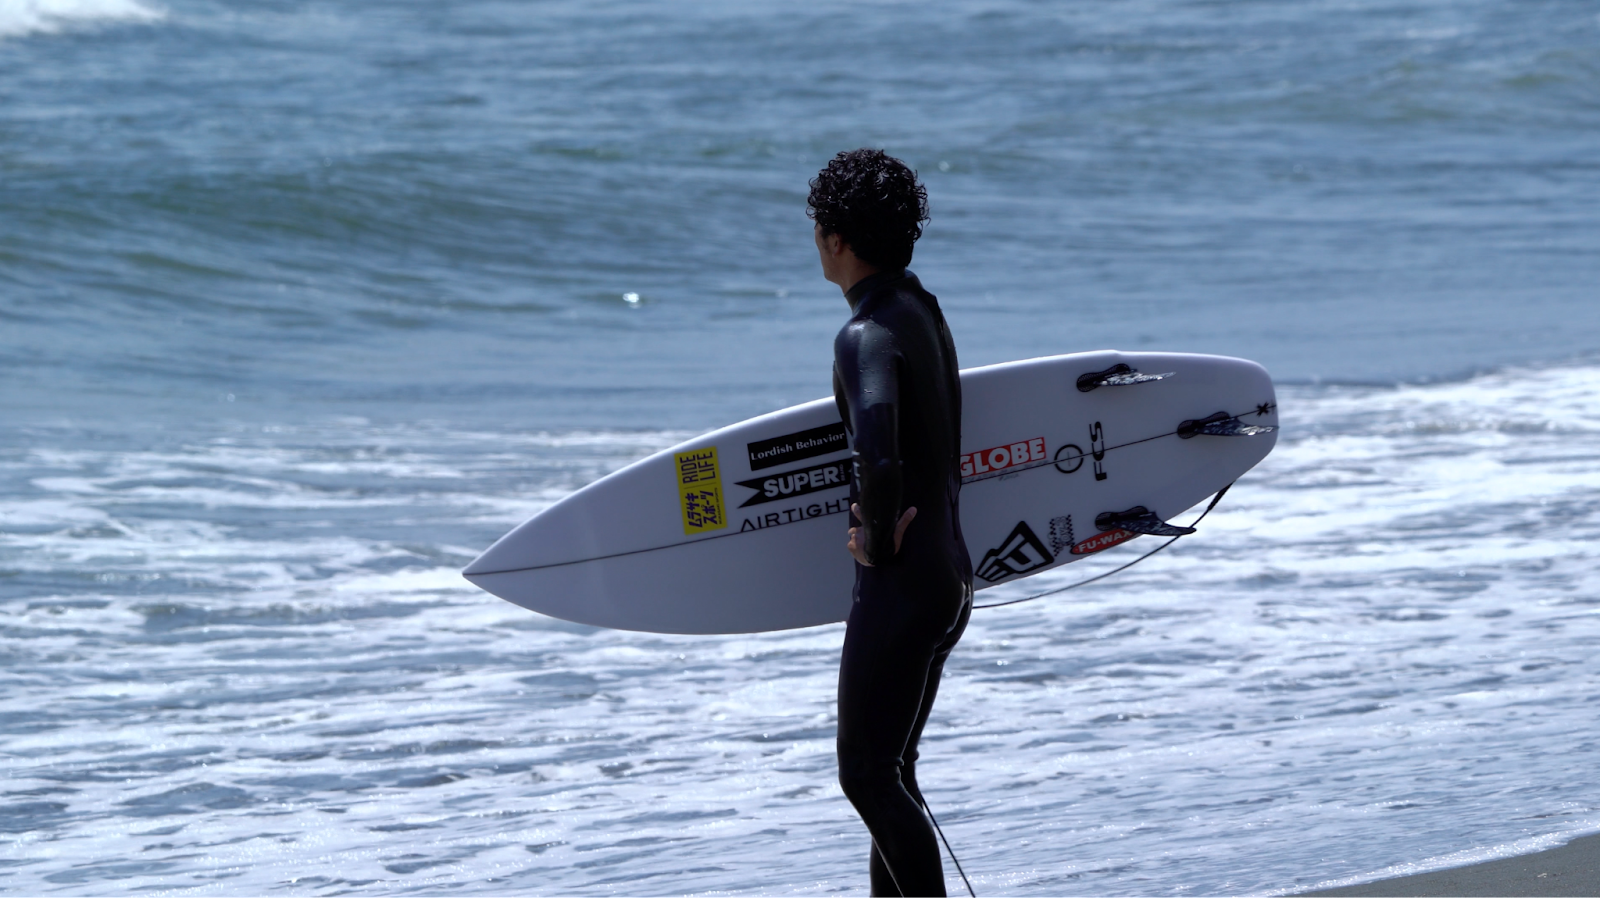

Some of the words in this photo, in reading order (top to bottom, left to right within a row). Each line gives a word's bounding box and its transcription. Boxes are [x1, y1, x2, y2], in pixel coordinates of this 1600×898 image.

[751, 443, 793, 461] Lordish
[796, 432, 845, 450] Behavior
[960, 438, 1045, 478] GLOBE
[680, 454, 699, 484] RIDE
[697, 451, 716, 481] LIFE
[763, 466, 841, 498] SUPER
[685, 493, 703, 528] ムラサキ
[700, 490, 718, 525] スポーツ
[1078, 530, 1133, 553] FU-WAX
